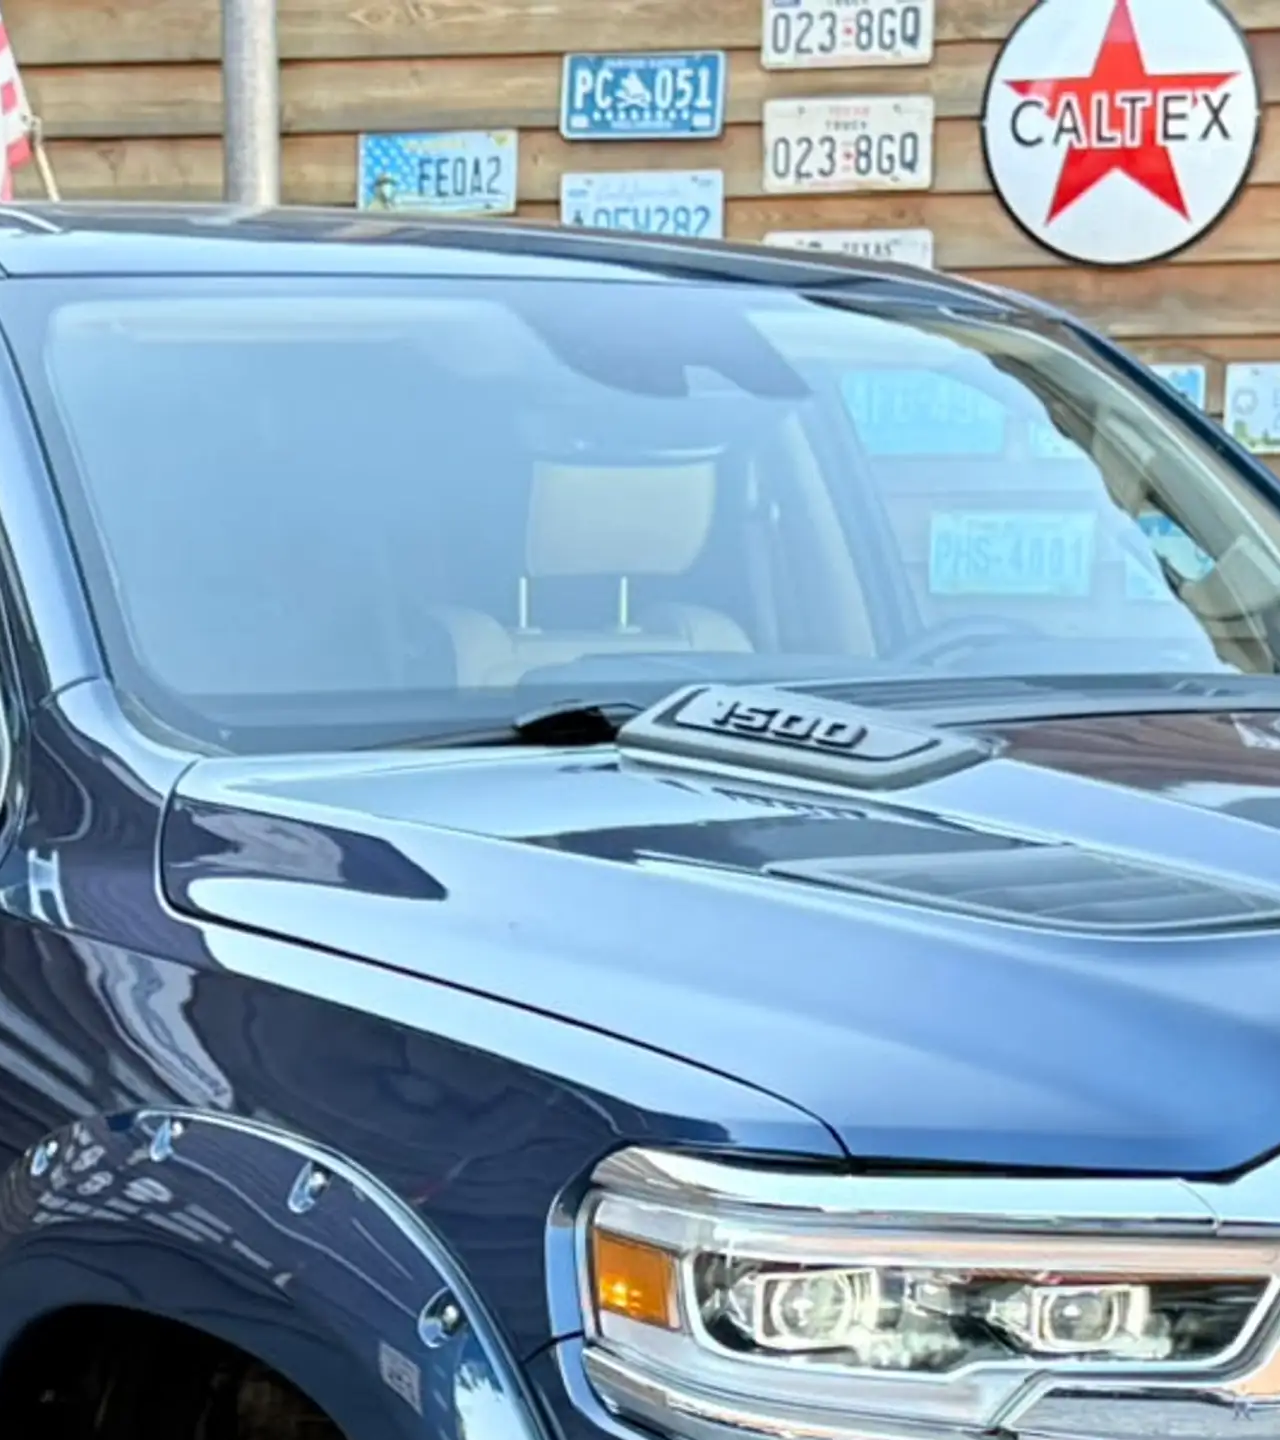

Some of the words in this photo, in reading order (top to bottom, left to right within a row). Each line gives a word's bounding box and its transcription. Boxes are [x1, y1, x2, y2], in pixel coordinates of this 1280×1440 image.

[772, 11, 837, 54] 023
[855, 6, 921, 51] 8GQ
[574, 68, 614, 109] PC
[654, 66, 712, 109] 051
[1010, 91, 1232, 147] CALTEX
[772, 136, 837, 179] 023
[854, 132, 920, 175] 8GQ
[712, 699, 868, 749] 1500
